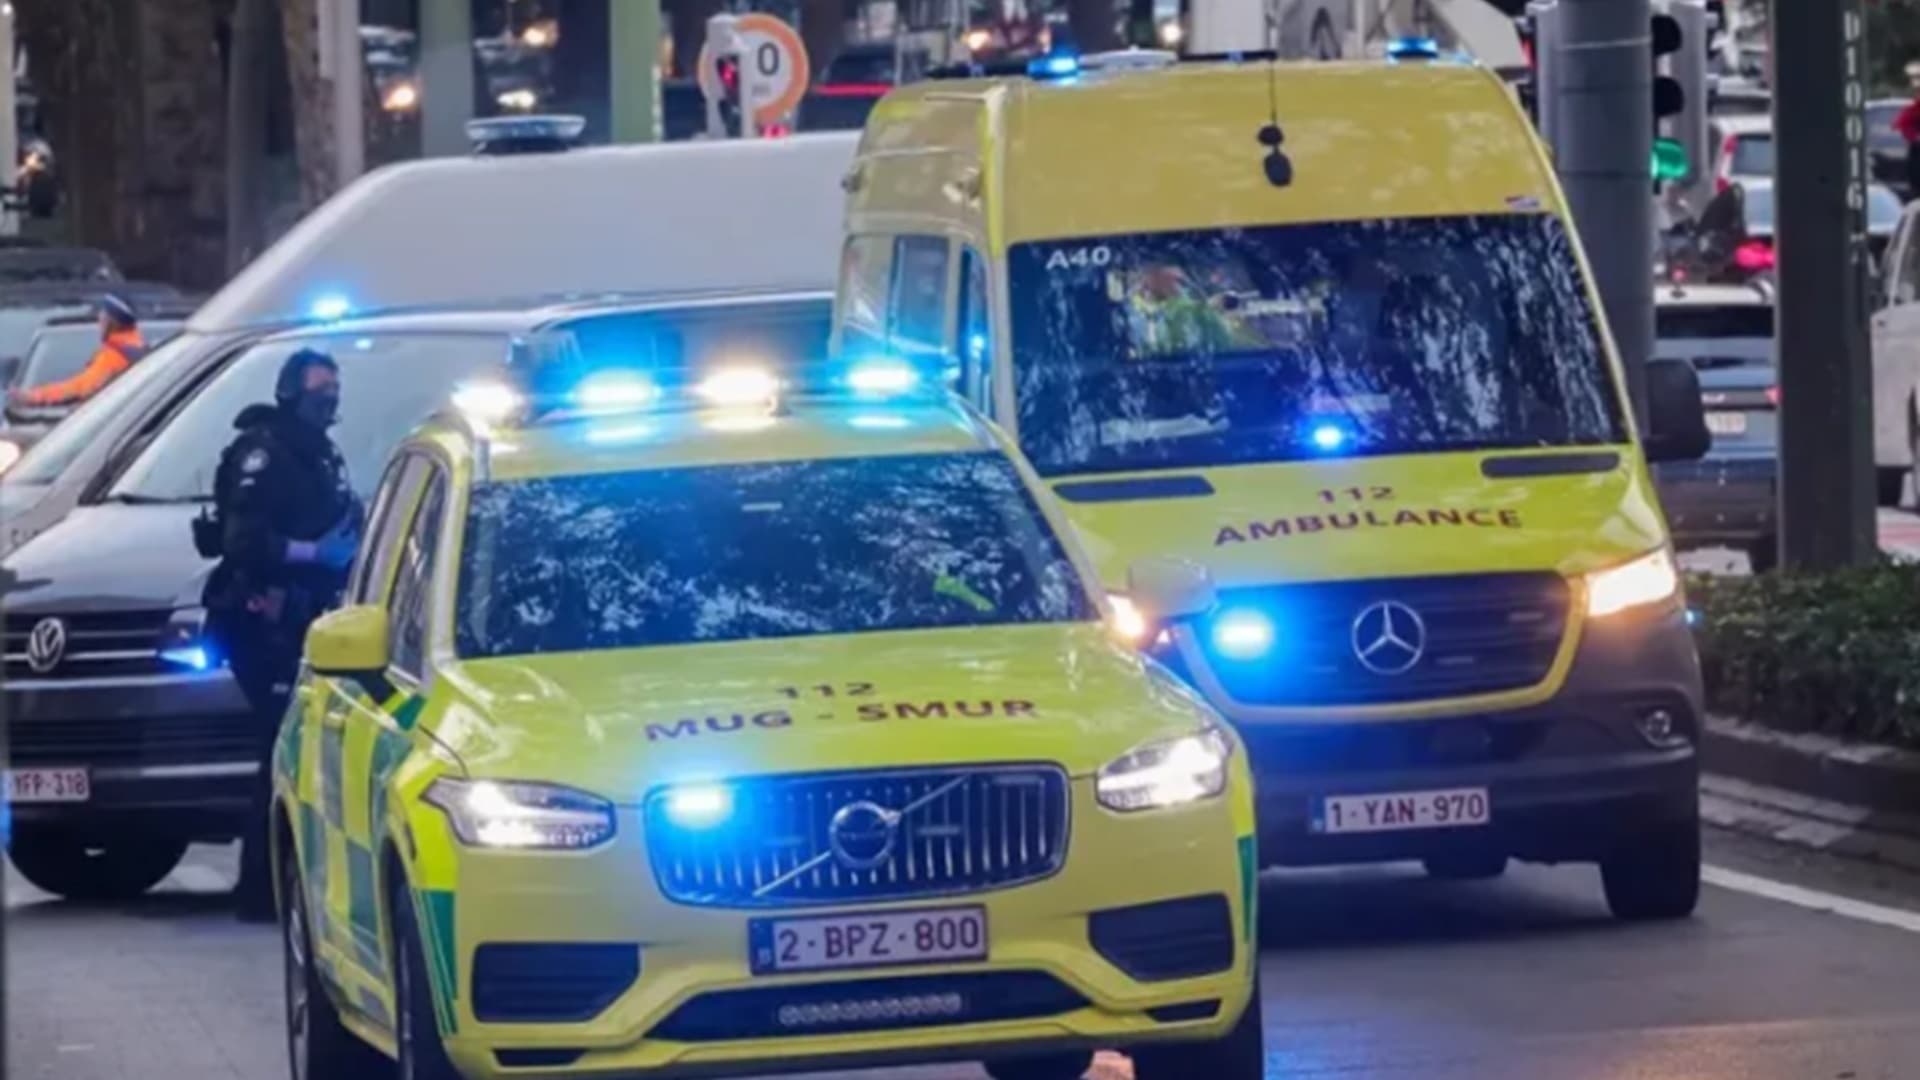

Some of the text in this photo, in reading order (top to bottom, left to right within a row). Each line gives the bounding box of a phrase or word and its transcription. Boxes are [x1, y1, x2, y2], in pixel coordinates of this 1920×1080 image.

[1046, 245, 1111, 270] A40
[1318, 486, 1394, 503] 112
[1214, 508, 1523, 546] AMBULANCE
[777, 682, 873, 699] 112
[645, 710, 792, 741] MUG
[857, 700, 1037, 722] SMUR
[1331, 793, 1485, 828] 1-YAN-970
[778, 915, 980, 963] 2-BPZ-800
